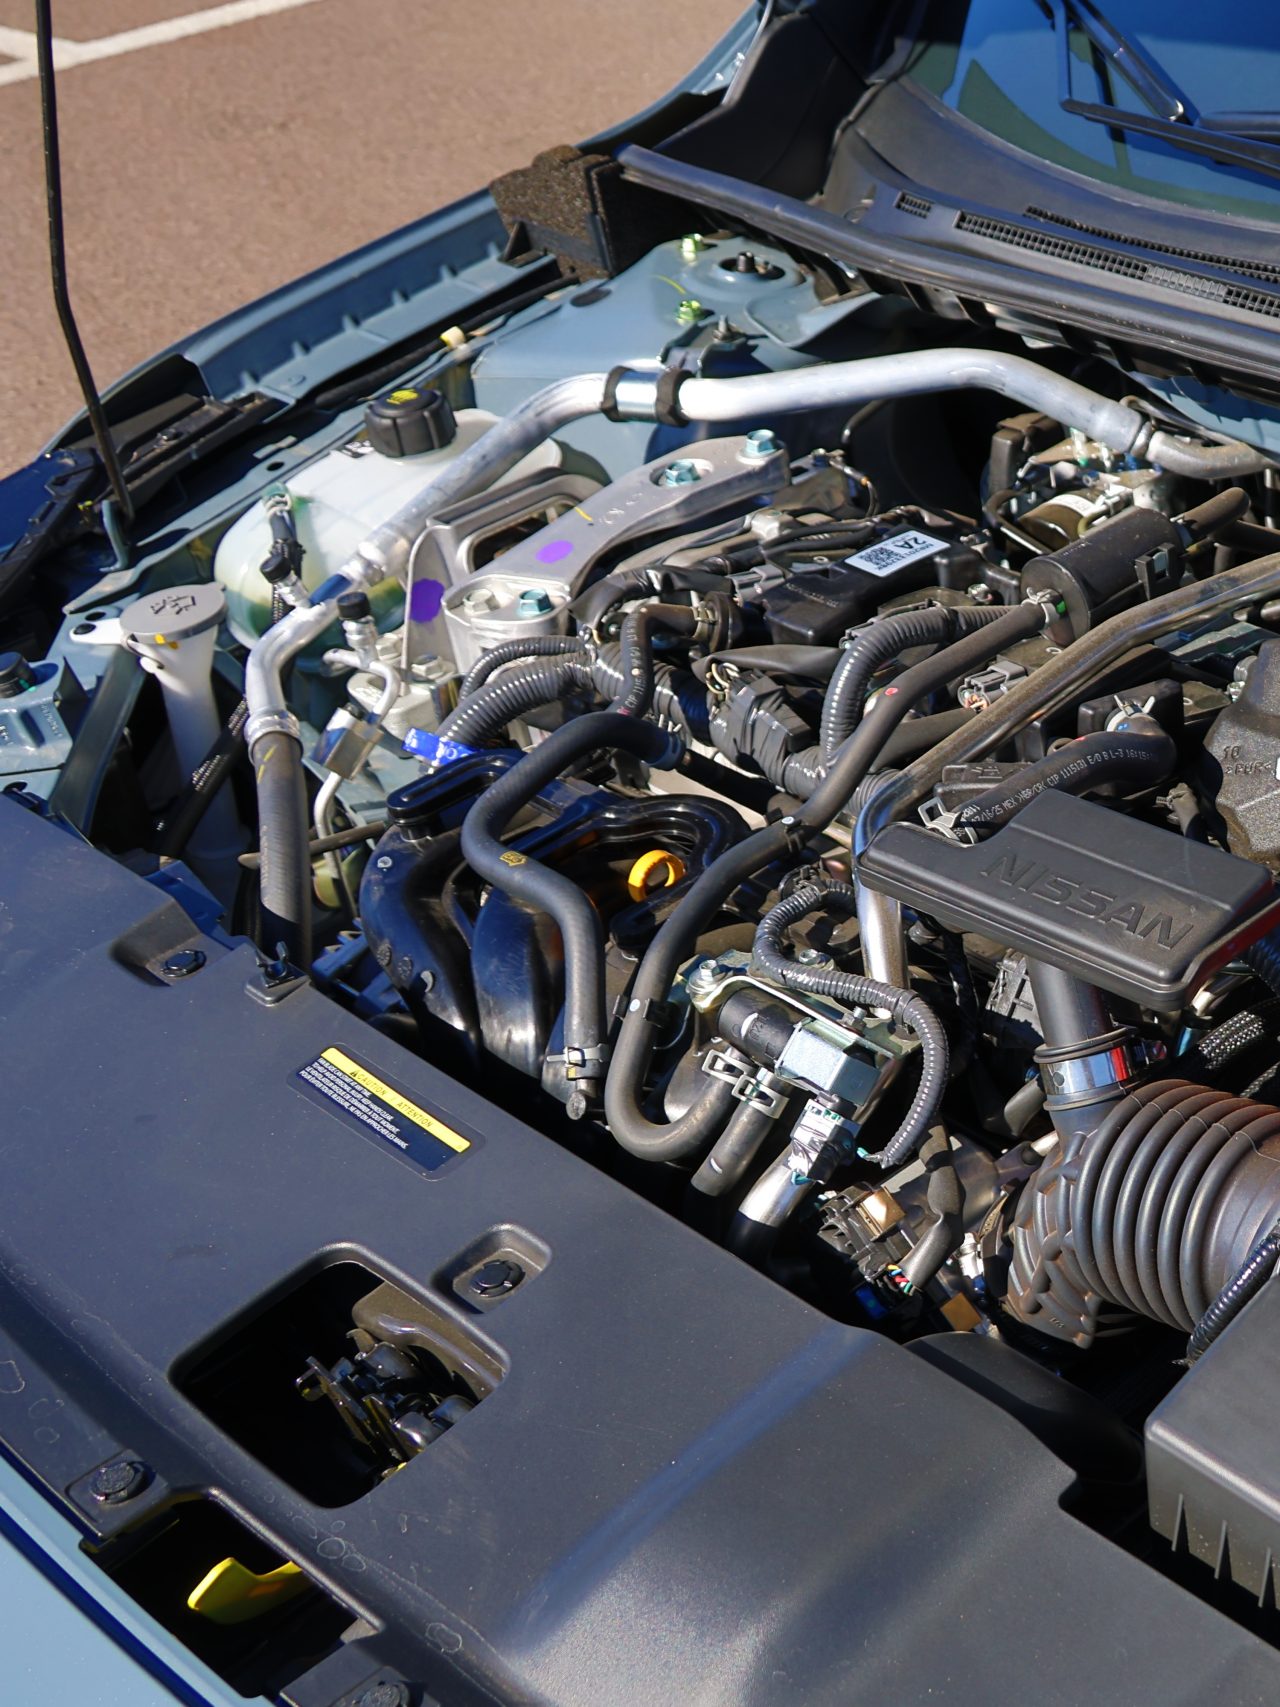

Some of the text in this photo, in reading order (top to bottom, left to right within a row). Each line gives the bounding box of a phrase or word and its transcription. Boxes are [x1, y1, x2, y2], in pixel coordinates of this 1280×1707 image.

[894, 536, 926, 550] 2A
[1002, 795, 1018, 812] MEX
[1046, 773, 1060, 788] CIP
[1060, 759, 1088, 779] 1115131
[1109, 748, 1124, 760] L-3
[981, 851, 1198, 952] NISSAN
[355, 1073, 388, 1096] CAUTION
[395, 1100, 434, 1128] ATTENTION
